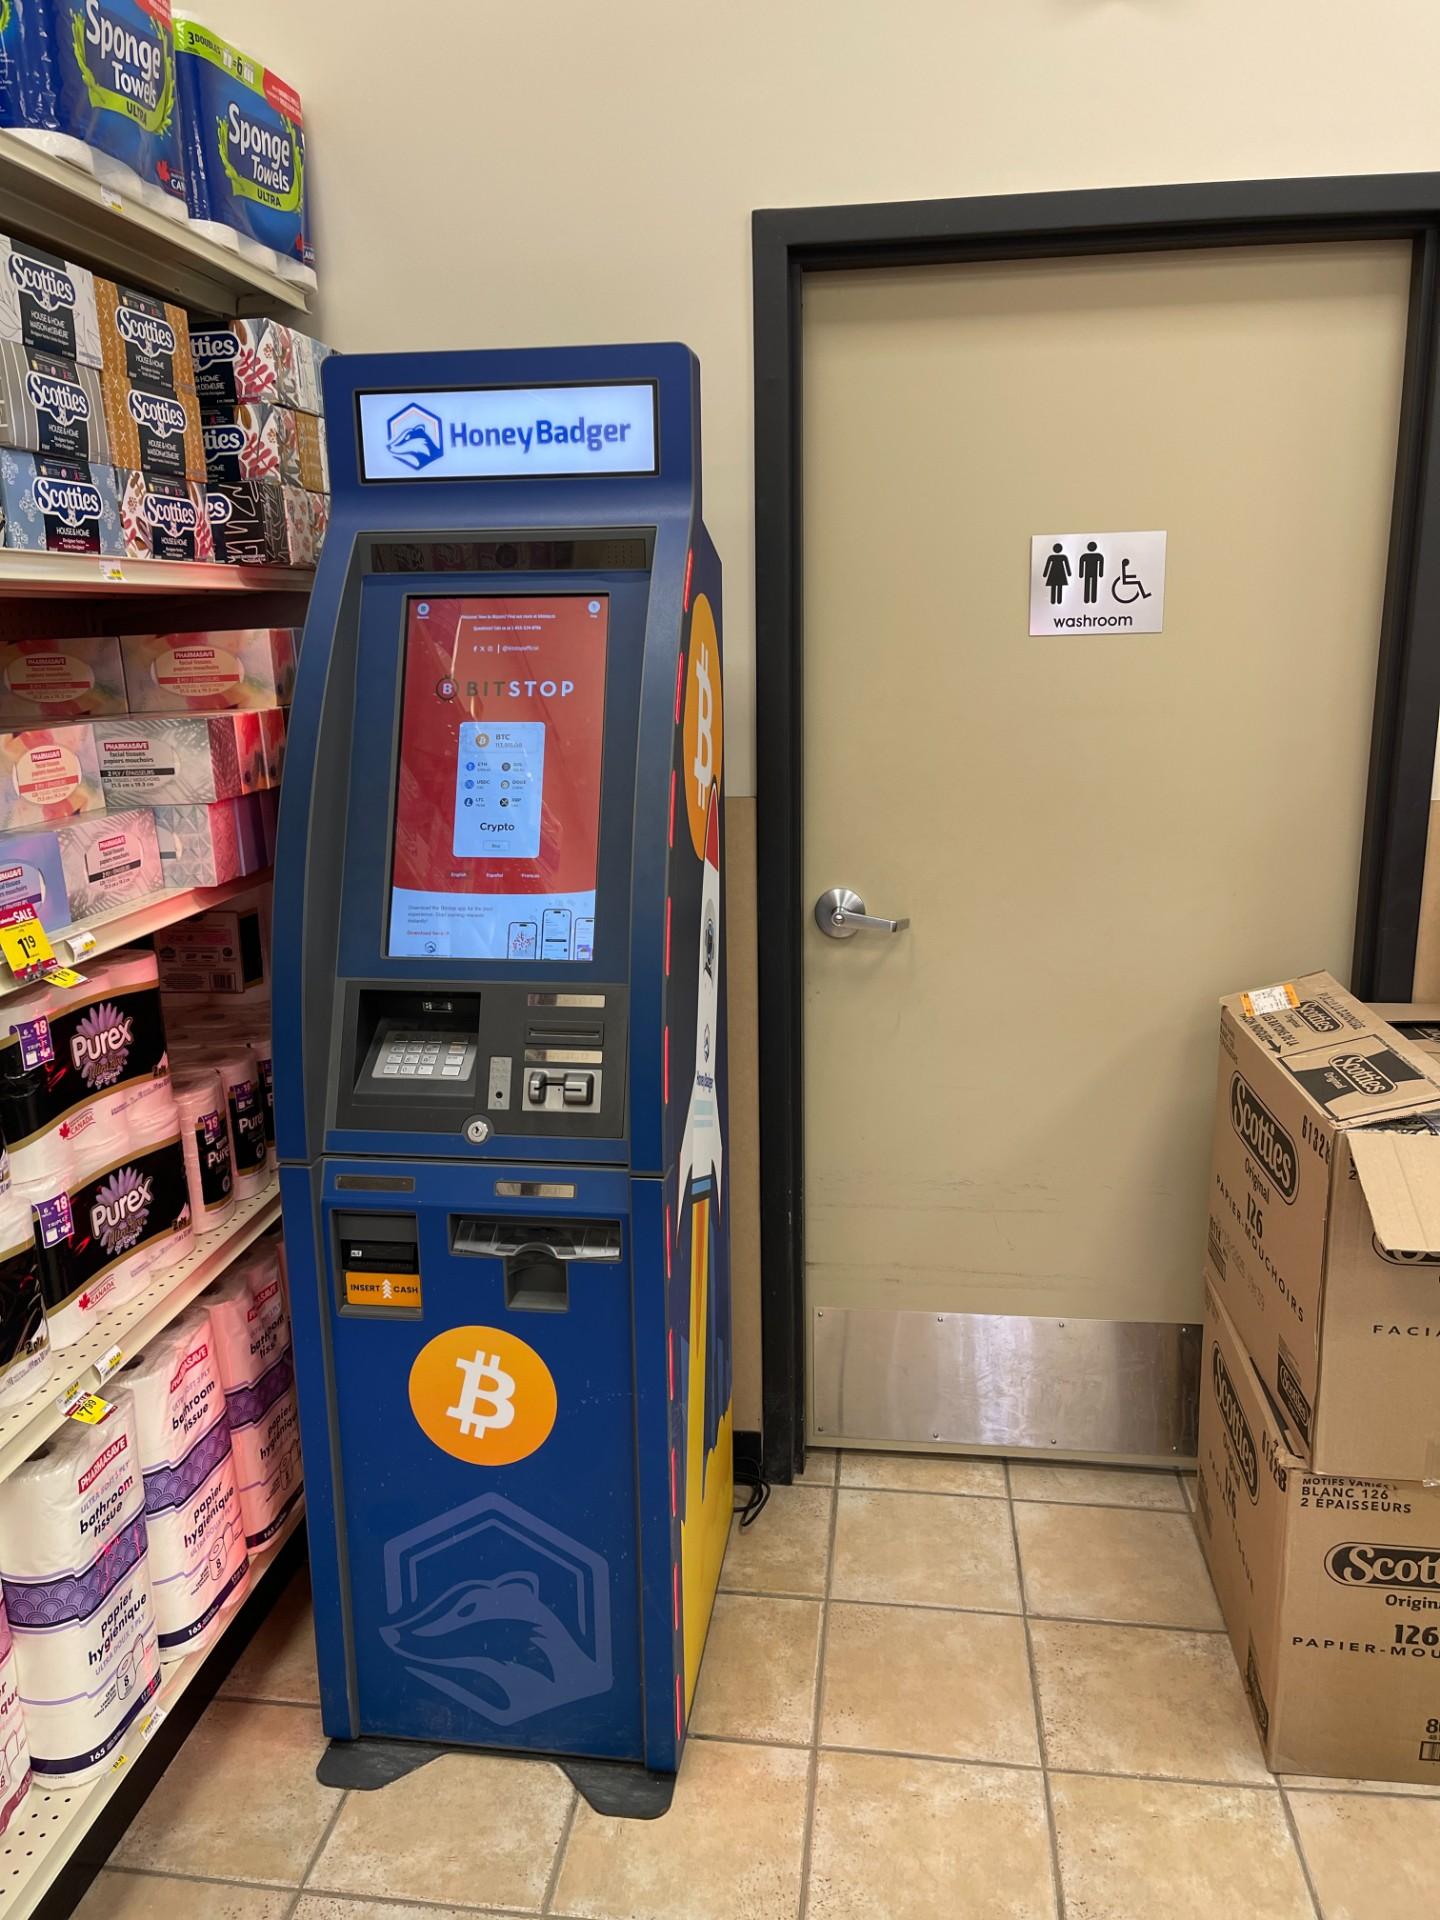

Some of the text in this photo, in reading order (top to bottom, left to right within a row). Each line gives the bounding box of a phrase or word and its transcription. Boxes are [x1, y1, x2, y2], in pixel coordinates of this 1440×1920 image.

[86, 0, 161, 81] Sponge
[111, 61, 157, 108] Towels
[126, 101, 147, 126] ULTRA
[228, 103, 290, 170] Sponge
[251, 155, 289, 192] Towels
[257, 188, 281, 207] ULTRA
[12, 255, 73, 302] Scotties
[120, 309, 172, 347] Scotties
[191, 335, 235, 357] tties
[31, 374, 86, 413] Scotties
[132, 392, 183, 427] Scotties
[450, 417, 631, 453] HoneyBadger
[38, 480, 98, 512] Scotties
[147, 496, 195, 527] Scotties
[1054, 615, 1133, 627] washroom
[467, 680, 574, 697] BITSTOP
[105, 742, 147, 751] PHARMASAVE
[480, 822, 515, 832] Crypto
[13, 908, 34, 923] SALE
[33, 1020, 47, 1035] 18
[72, 1019, 132, 1068] Purex
[1332, 1056, 1386, 1093] Scotties
[70, 1114, 94, 1135] CANADA
[1234, 1080, 1292, 1188] Scotties
[1245, 1157, 1270, 1205] Original
[54, 1196, 68, 1212] 18
[92, 1178, 152, 1237] Purex
[1247, 1192, 1263, 1239] 126
[1217, 1174, 1304, 1323] PAPIER-MOUCHOIRS
[90, 1280, 115, 1304] CANADA
[351, 1284, 418, 1294] INSERT CASH
[1373, 1325, 1440, 1338] FACI
[183, 1403, 208, 1434] tissue
[1216, 1353, 1255, 1482] Scotties
[80, 1437, 126, 1491] PHARMASAVE
[1302, 1486, 1389, 1500] BLANC 126
[1303, 1478, 1345, 1486] MOTIFS
[80, 1474, 133, 1535] bathroom
[184, 1486, 234, 1549] hygiénique
[194, 1481, 222, 1523] papier
[1301, 1496, 1412, 1513] 2 ÉPAISSEURS
[94, 1501, 122, 1538] tissue
[216, 1558, 221, 1569] 8
[101, 1587, 133, 1638] papier
[88, 1593, 147, 1666] hygiénique
[188, 1623, 202, 1637] 165
[1395, 1624, 1440, 1646] 126
[123, 1675, 129, 1688] 8
[89, 1749, 106, 1762] 165
